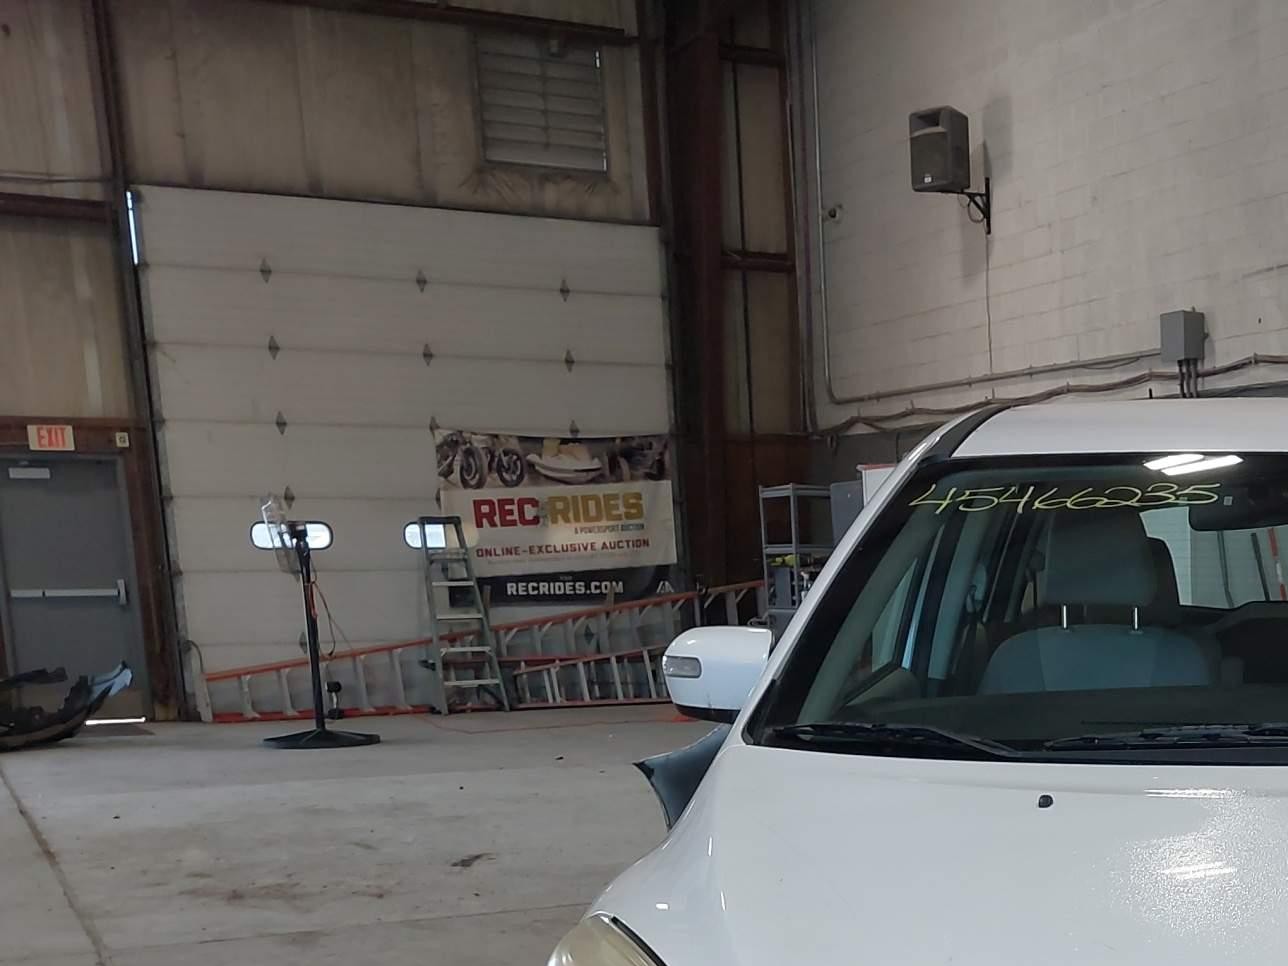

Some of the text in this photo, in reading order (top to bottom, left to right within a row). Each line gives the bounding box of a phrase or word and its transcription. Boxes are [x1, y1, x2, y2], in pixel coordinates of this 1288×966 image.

[37, 426, 65, 448] EXIT
[909, 483, 1221, 514] 45466235
[473, 492, 644, 528] REC RIDES
[476, 538, 650, 558] ONLINE-EXCLUSIVE AUCTION
[507, 581, 623, 596] RECRIDES.COM
